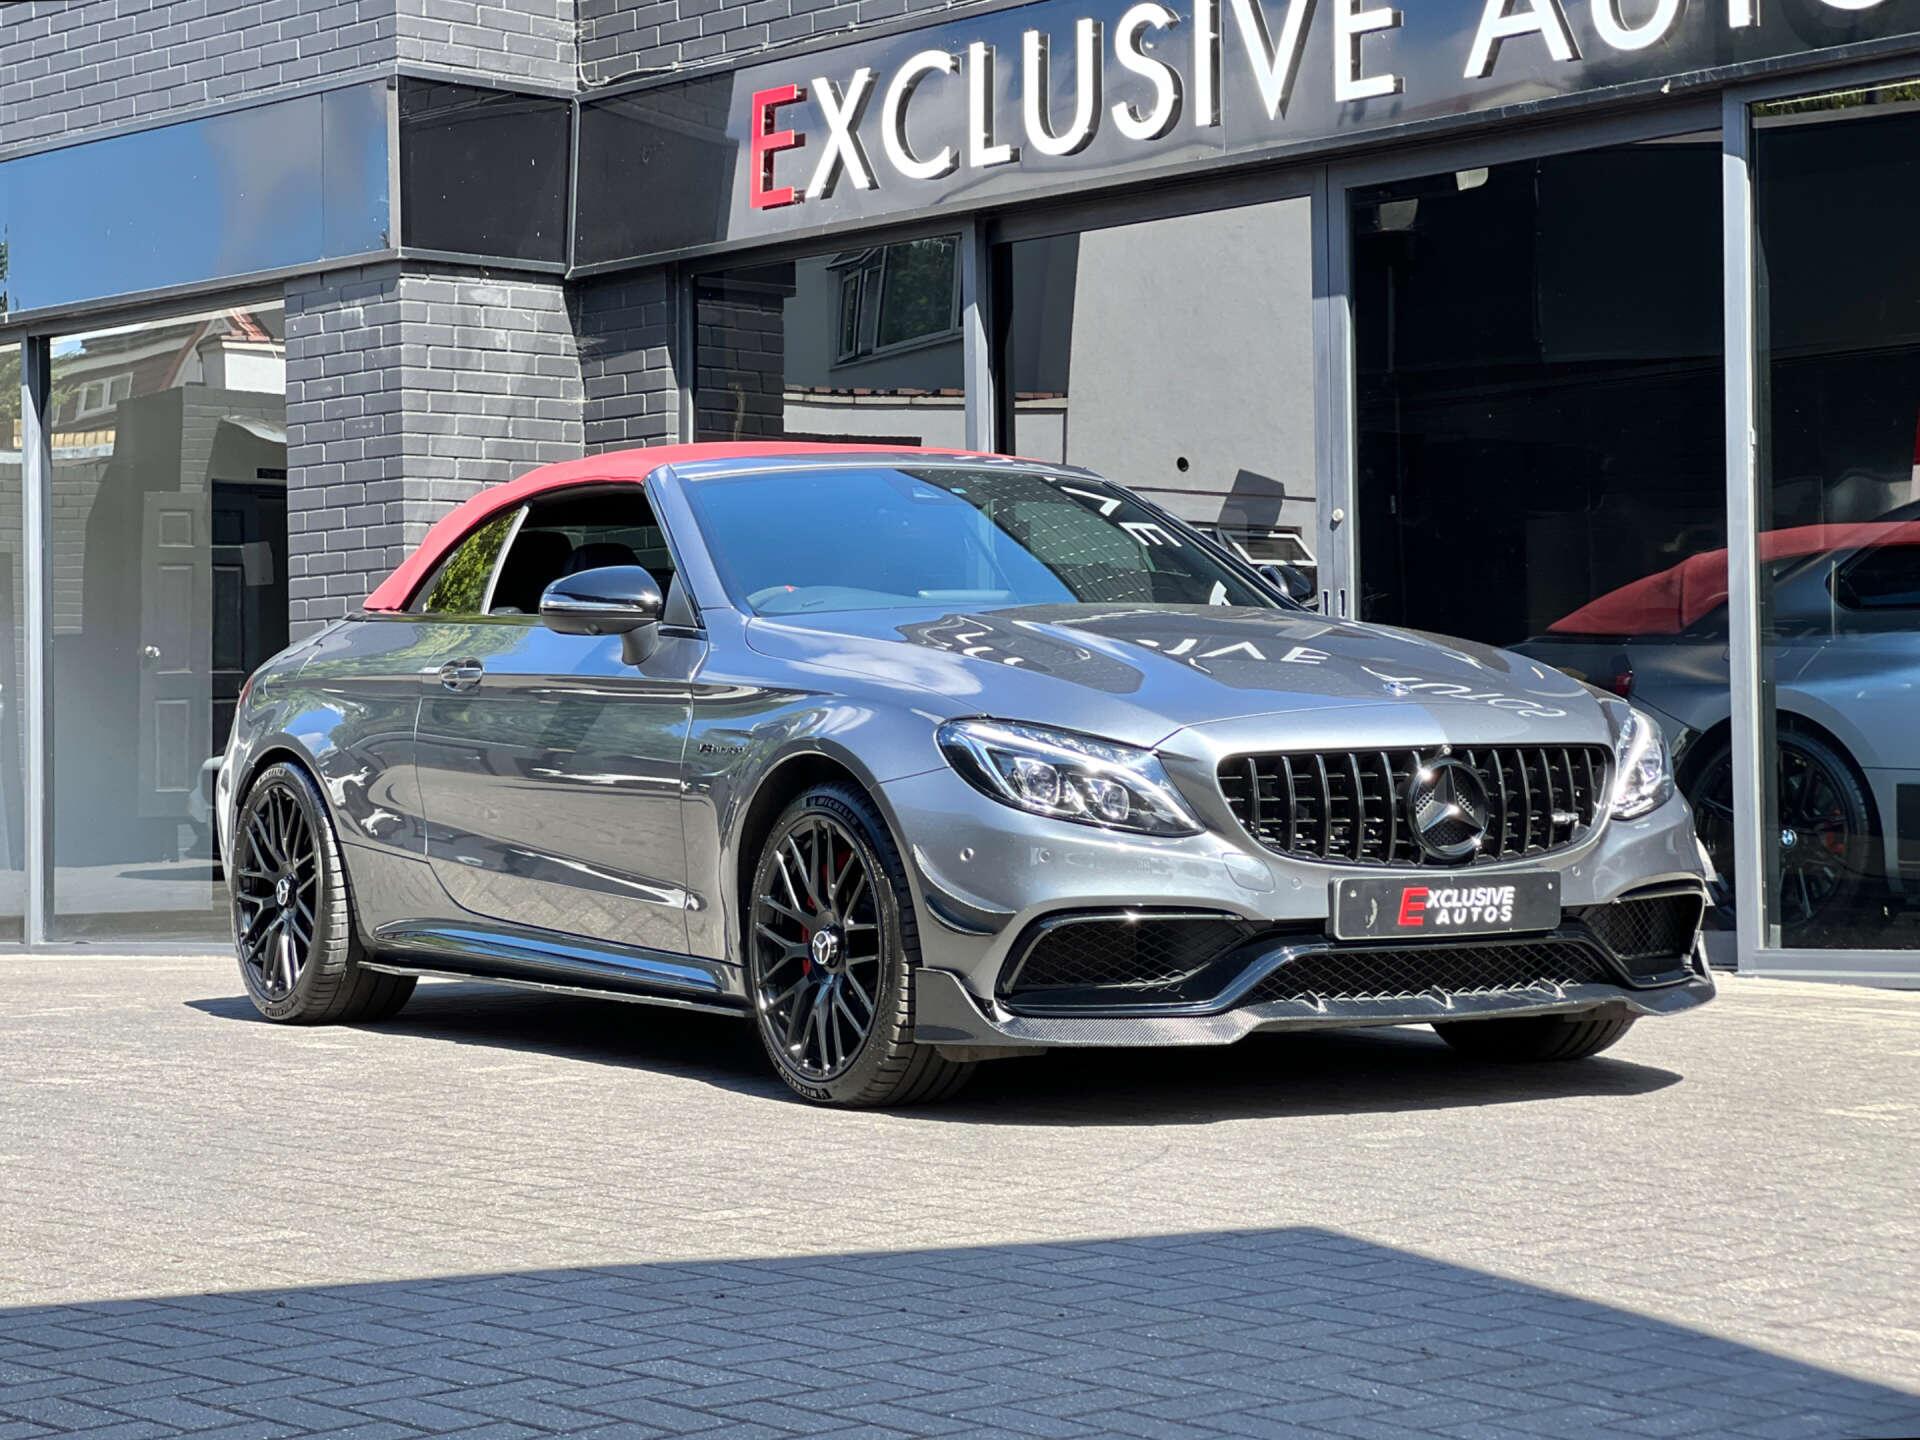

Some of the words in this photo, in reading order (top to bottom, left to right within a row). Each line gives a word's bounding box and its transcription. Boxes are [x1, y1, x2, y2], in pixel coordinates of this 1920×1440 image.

[750, 0, 1397, 209] EXCLUSIVE
[1398, 886, 1515, 925] EXCLUSIVE
[1435, 905, 1513, 925] AUTOS
